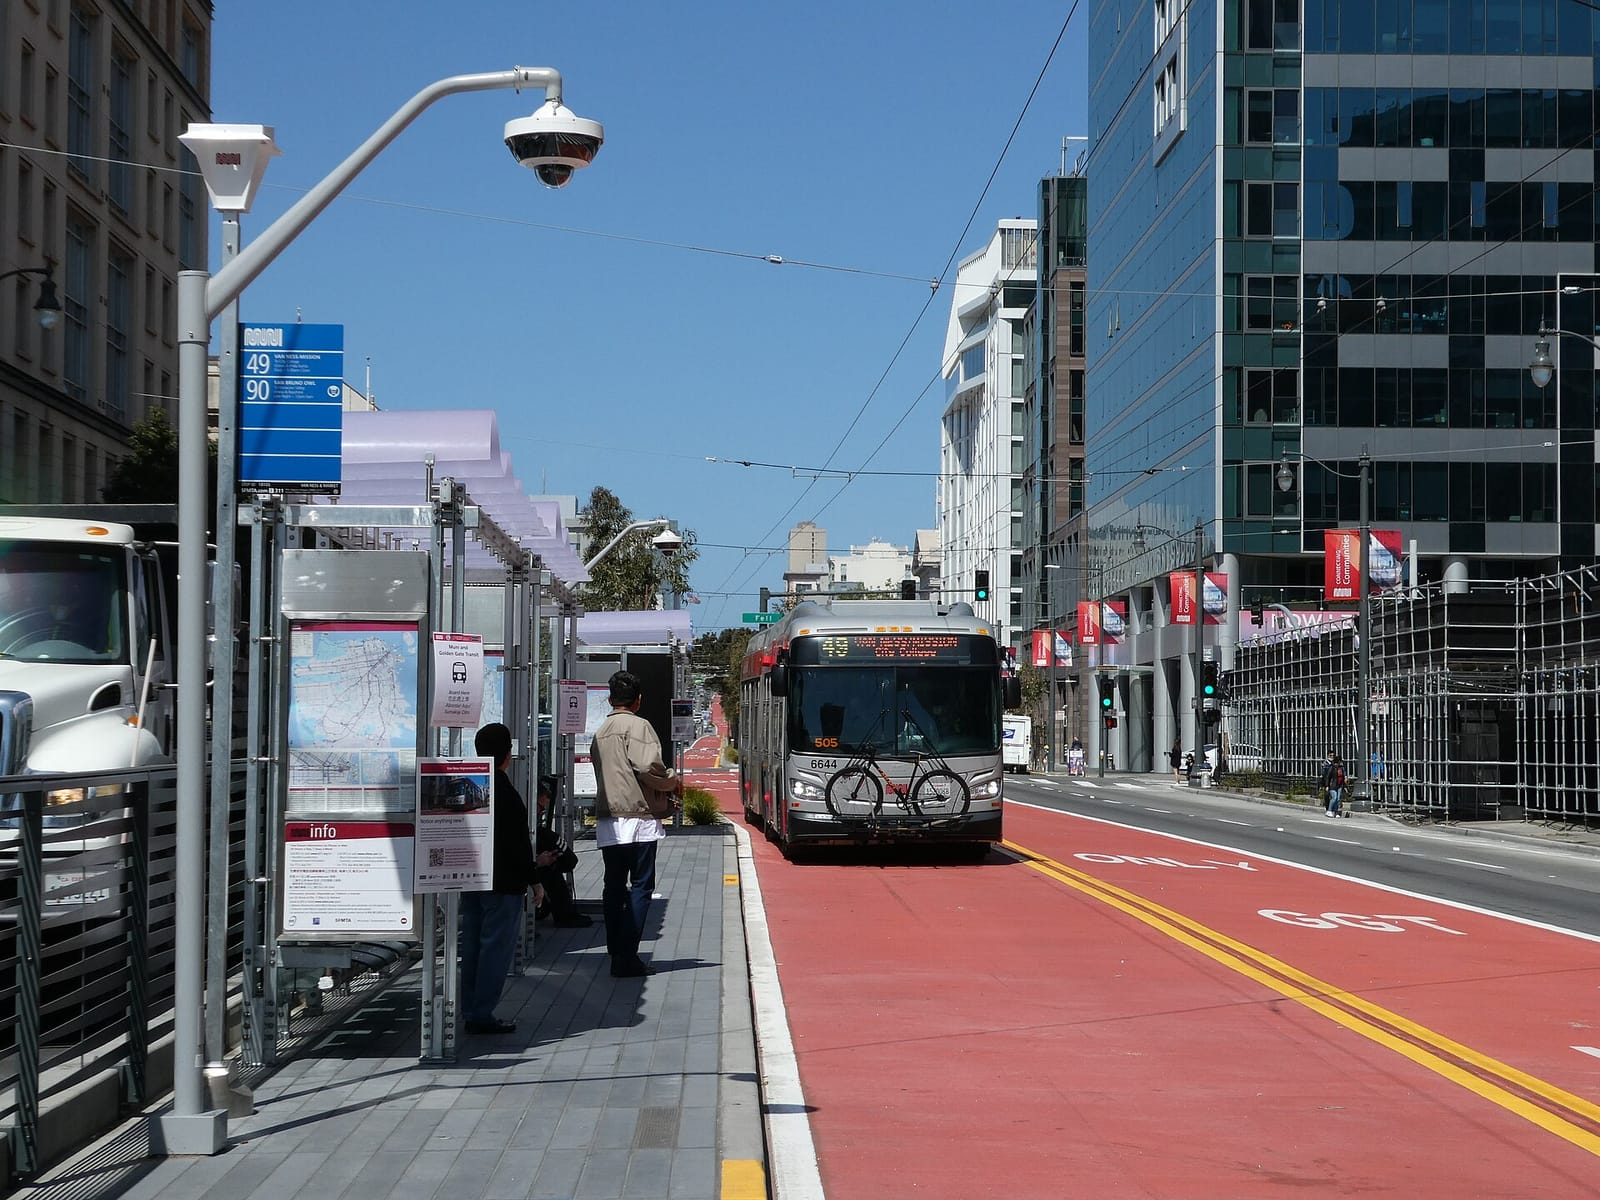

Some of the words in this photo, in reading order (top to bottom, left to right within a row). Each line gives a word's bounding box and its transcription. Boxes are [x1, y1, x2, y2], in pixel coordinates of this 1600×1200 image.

[246, 353, 271, 375] 49
[246, 379, 270, 401] 90
[1343, 534, 1351, 585] Communities
[822, 637, 849, 657] 49
[814, 737, 839, 748] 505
[810, 759, 838, 769] 6644
[310, 823, 337, 838] info
[1073, 853, 1259, 872] ONLY
[1256, 909, 1469, 936] GGT
